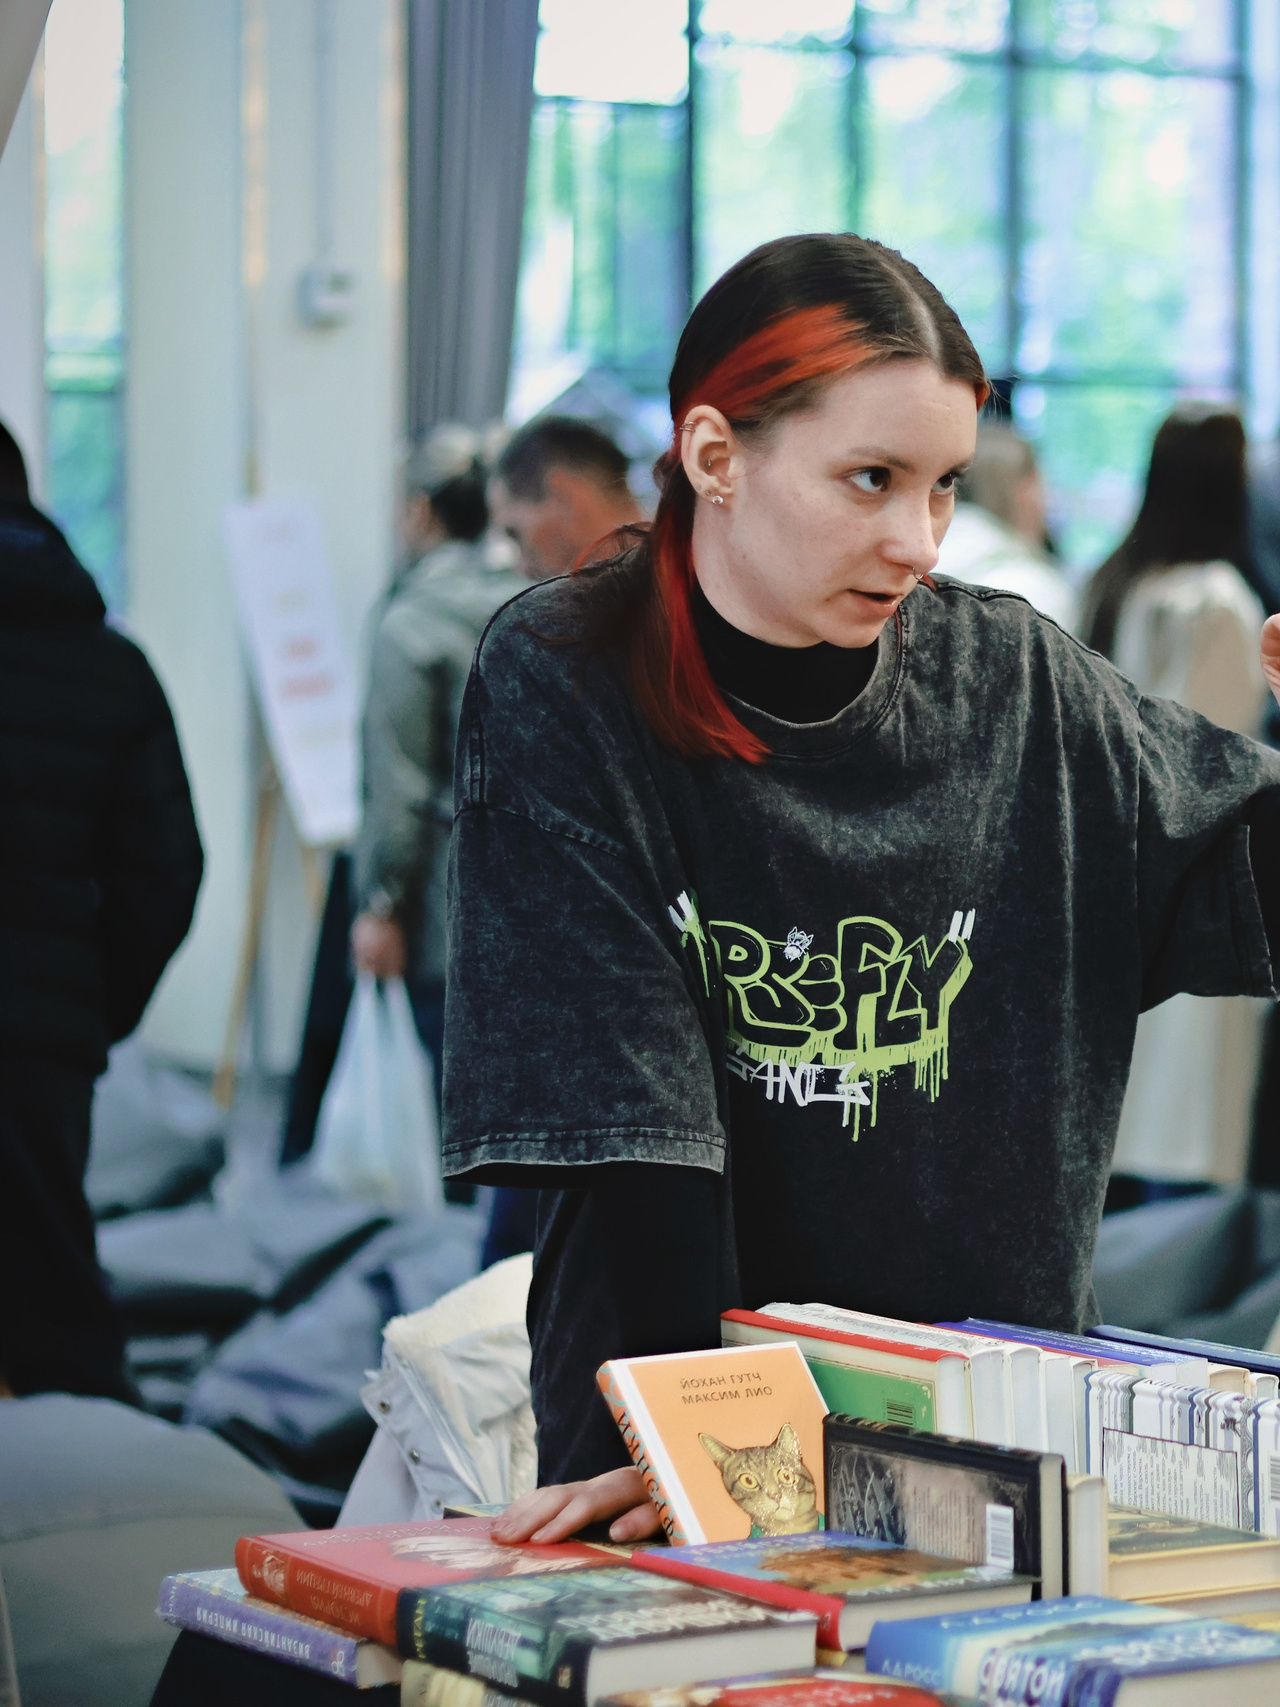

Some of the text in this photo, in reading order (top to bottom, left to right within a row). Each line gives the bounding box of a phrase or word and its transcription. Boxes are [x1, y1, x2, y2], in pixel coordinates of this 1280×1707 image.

[679, 1370, 762, 1390] ЙОХАН ГУТЧ
[681, 1385, 773, 1405] МАКСИМ ЛИО
[296, 1569, 373, 1607] ДРЕВНЕЙ ГРЕЦИИ
[196, 1605, 310, 1660] ВИЗАНТИЙСКАЯ ИМПЕРИЯ
